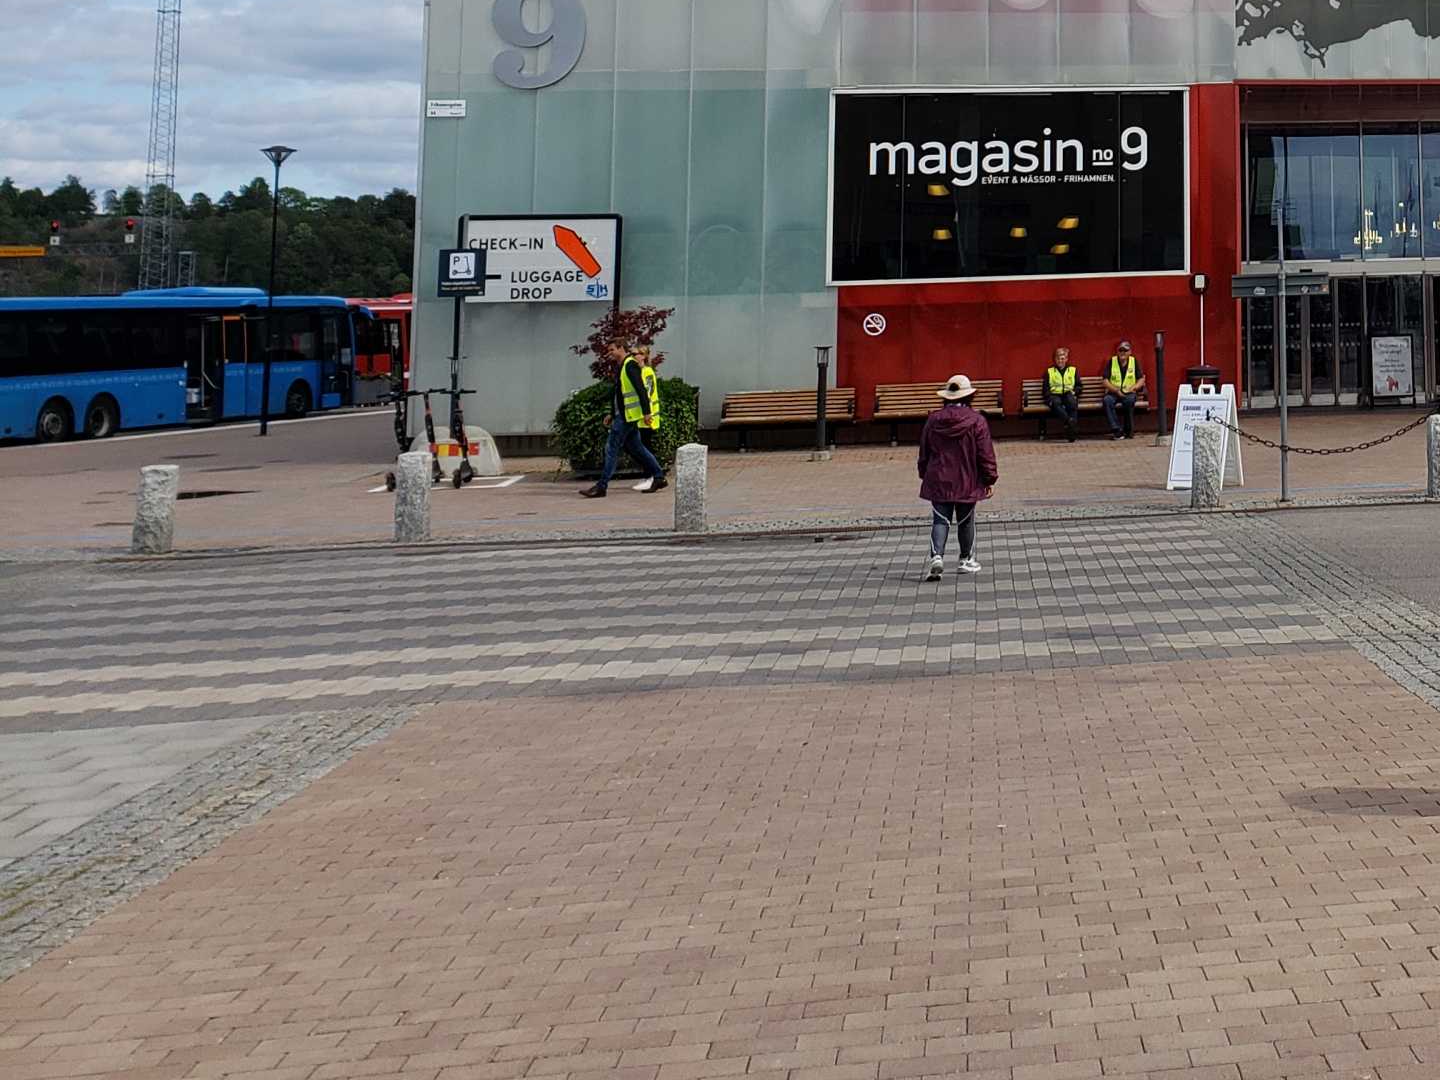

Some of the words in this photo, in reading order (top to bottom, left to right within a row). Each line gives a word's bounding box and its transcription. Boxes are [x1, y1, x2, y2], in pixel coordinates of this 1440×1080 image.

[869, 127, 1084, 186] magasin
[1092, 147, 1114, 166] no
[1120, 126, 1148, 171] 9
[981, 174, 1009, 185] EVENT
[1012, 174, 1019, 185] &
[1063, 173, 1115, 183] FRIHAMNEN
[469, 238, 544, 250] CHECK-IN
[511, 270, 583, 283] LUGGAGE
[510, 287, 552, 300] DROP
